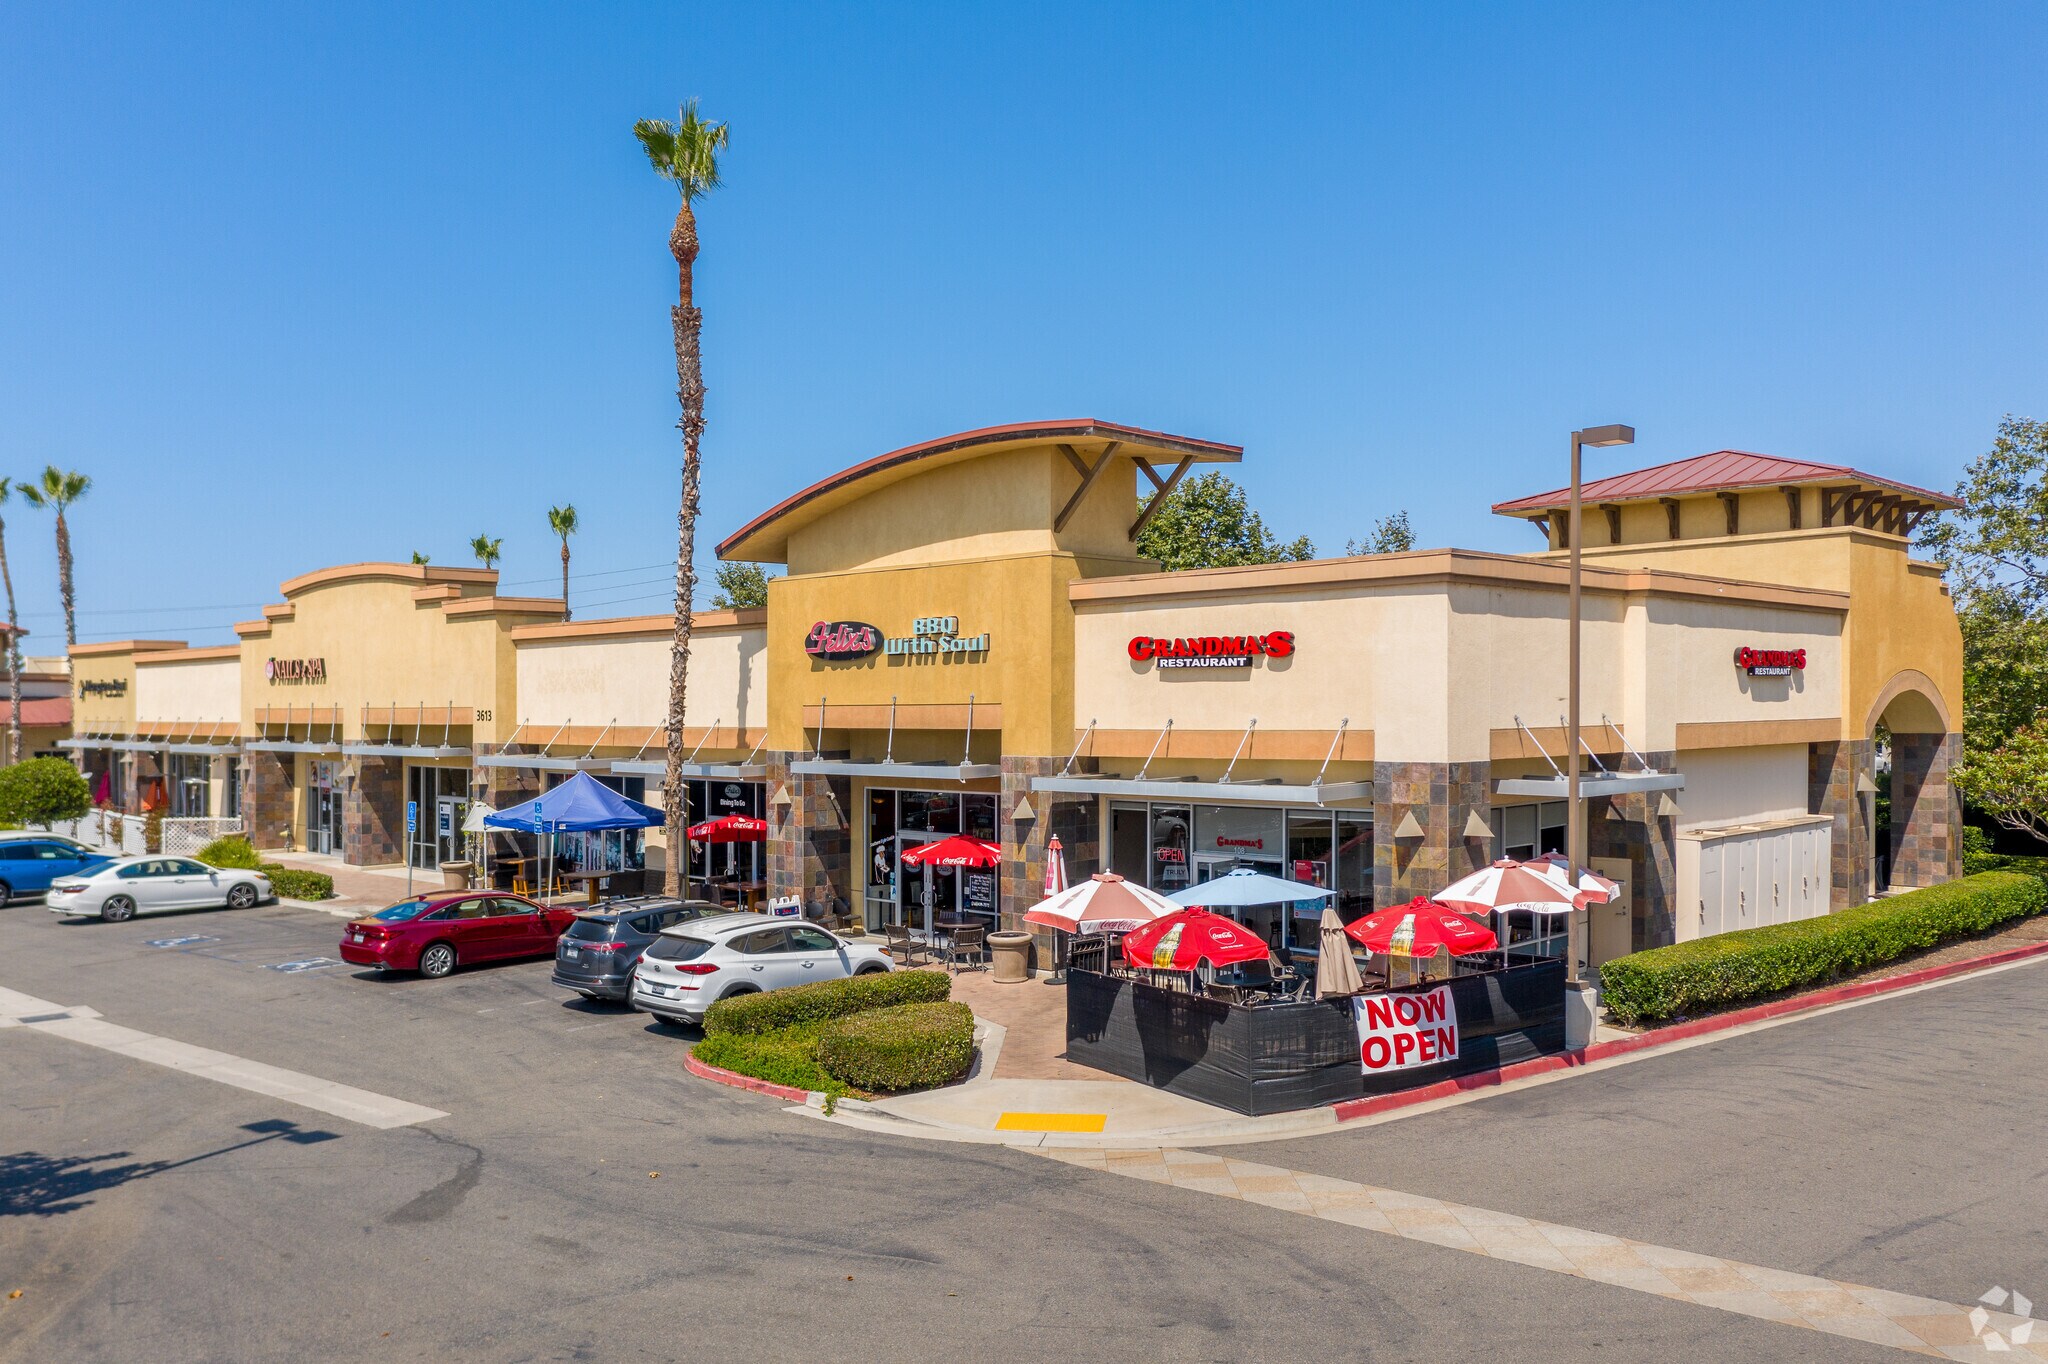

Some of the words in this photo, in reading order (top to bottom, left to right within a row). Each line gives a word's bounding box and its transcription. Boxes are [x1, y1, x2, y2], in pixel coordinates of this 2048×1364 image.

[913, 616, 958, 635] BBQ
[805, 620, 873, 654] Felix's
[938, 633, 990, 653] Soul
[274, 659, 301, 679] NAILS
[307, 657, 324, 678] SPA
[1159, 657, 1246, 668] RESTAURANT
[1754, 667, 1790, 675] RESTAURANT
[476, 709, 492, 722] 3613
[1158, 847, 1185, 862] OPEN
[1365, 991, 1446, 1031] NOW
[1361, 1025, 1456, 1069] OPEN
